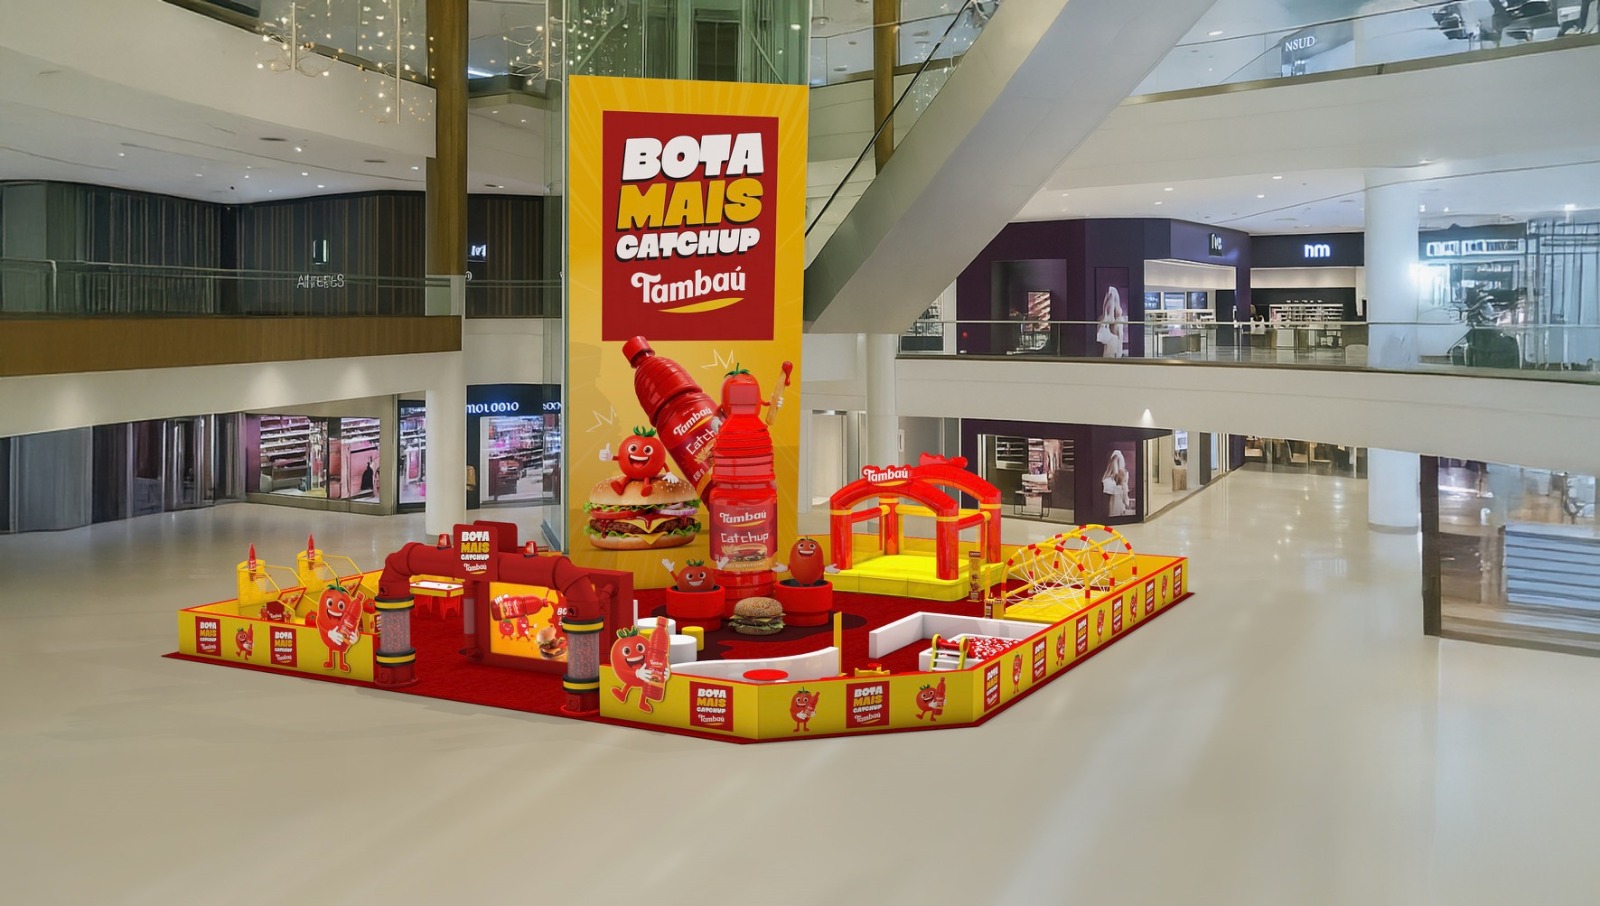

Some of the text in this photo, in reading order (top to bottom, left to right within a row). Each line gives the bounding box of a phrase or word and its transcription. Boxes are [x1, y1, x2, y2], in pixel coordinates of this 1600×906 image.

[621, 132, 765, 182] BOTA
[615, 178, 764, 232] MAIS
[615, 227, 761, 262] CATCHUP
[630, 265, 746, 304] Tambaú
[673, 406, 713, 436] Tambaú
[685, 428, 715, 455] Catch
[863, 467, 909, 482] Tambaú
[719, 510, 767, 524] Tambaú
[461, 531, 490, 542] BOTA
[720, 531, 769, 544] Catchup
[460, 542, 490, 554] MAIS
[697, 688, 727, 699] BOTA
[854, 685, 883, 698] BOTA
[696, 697, 727, 708] MAIS
[853, 694, 883, 707] MAIS
